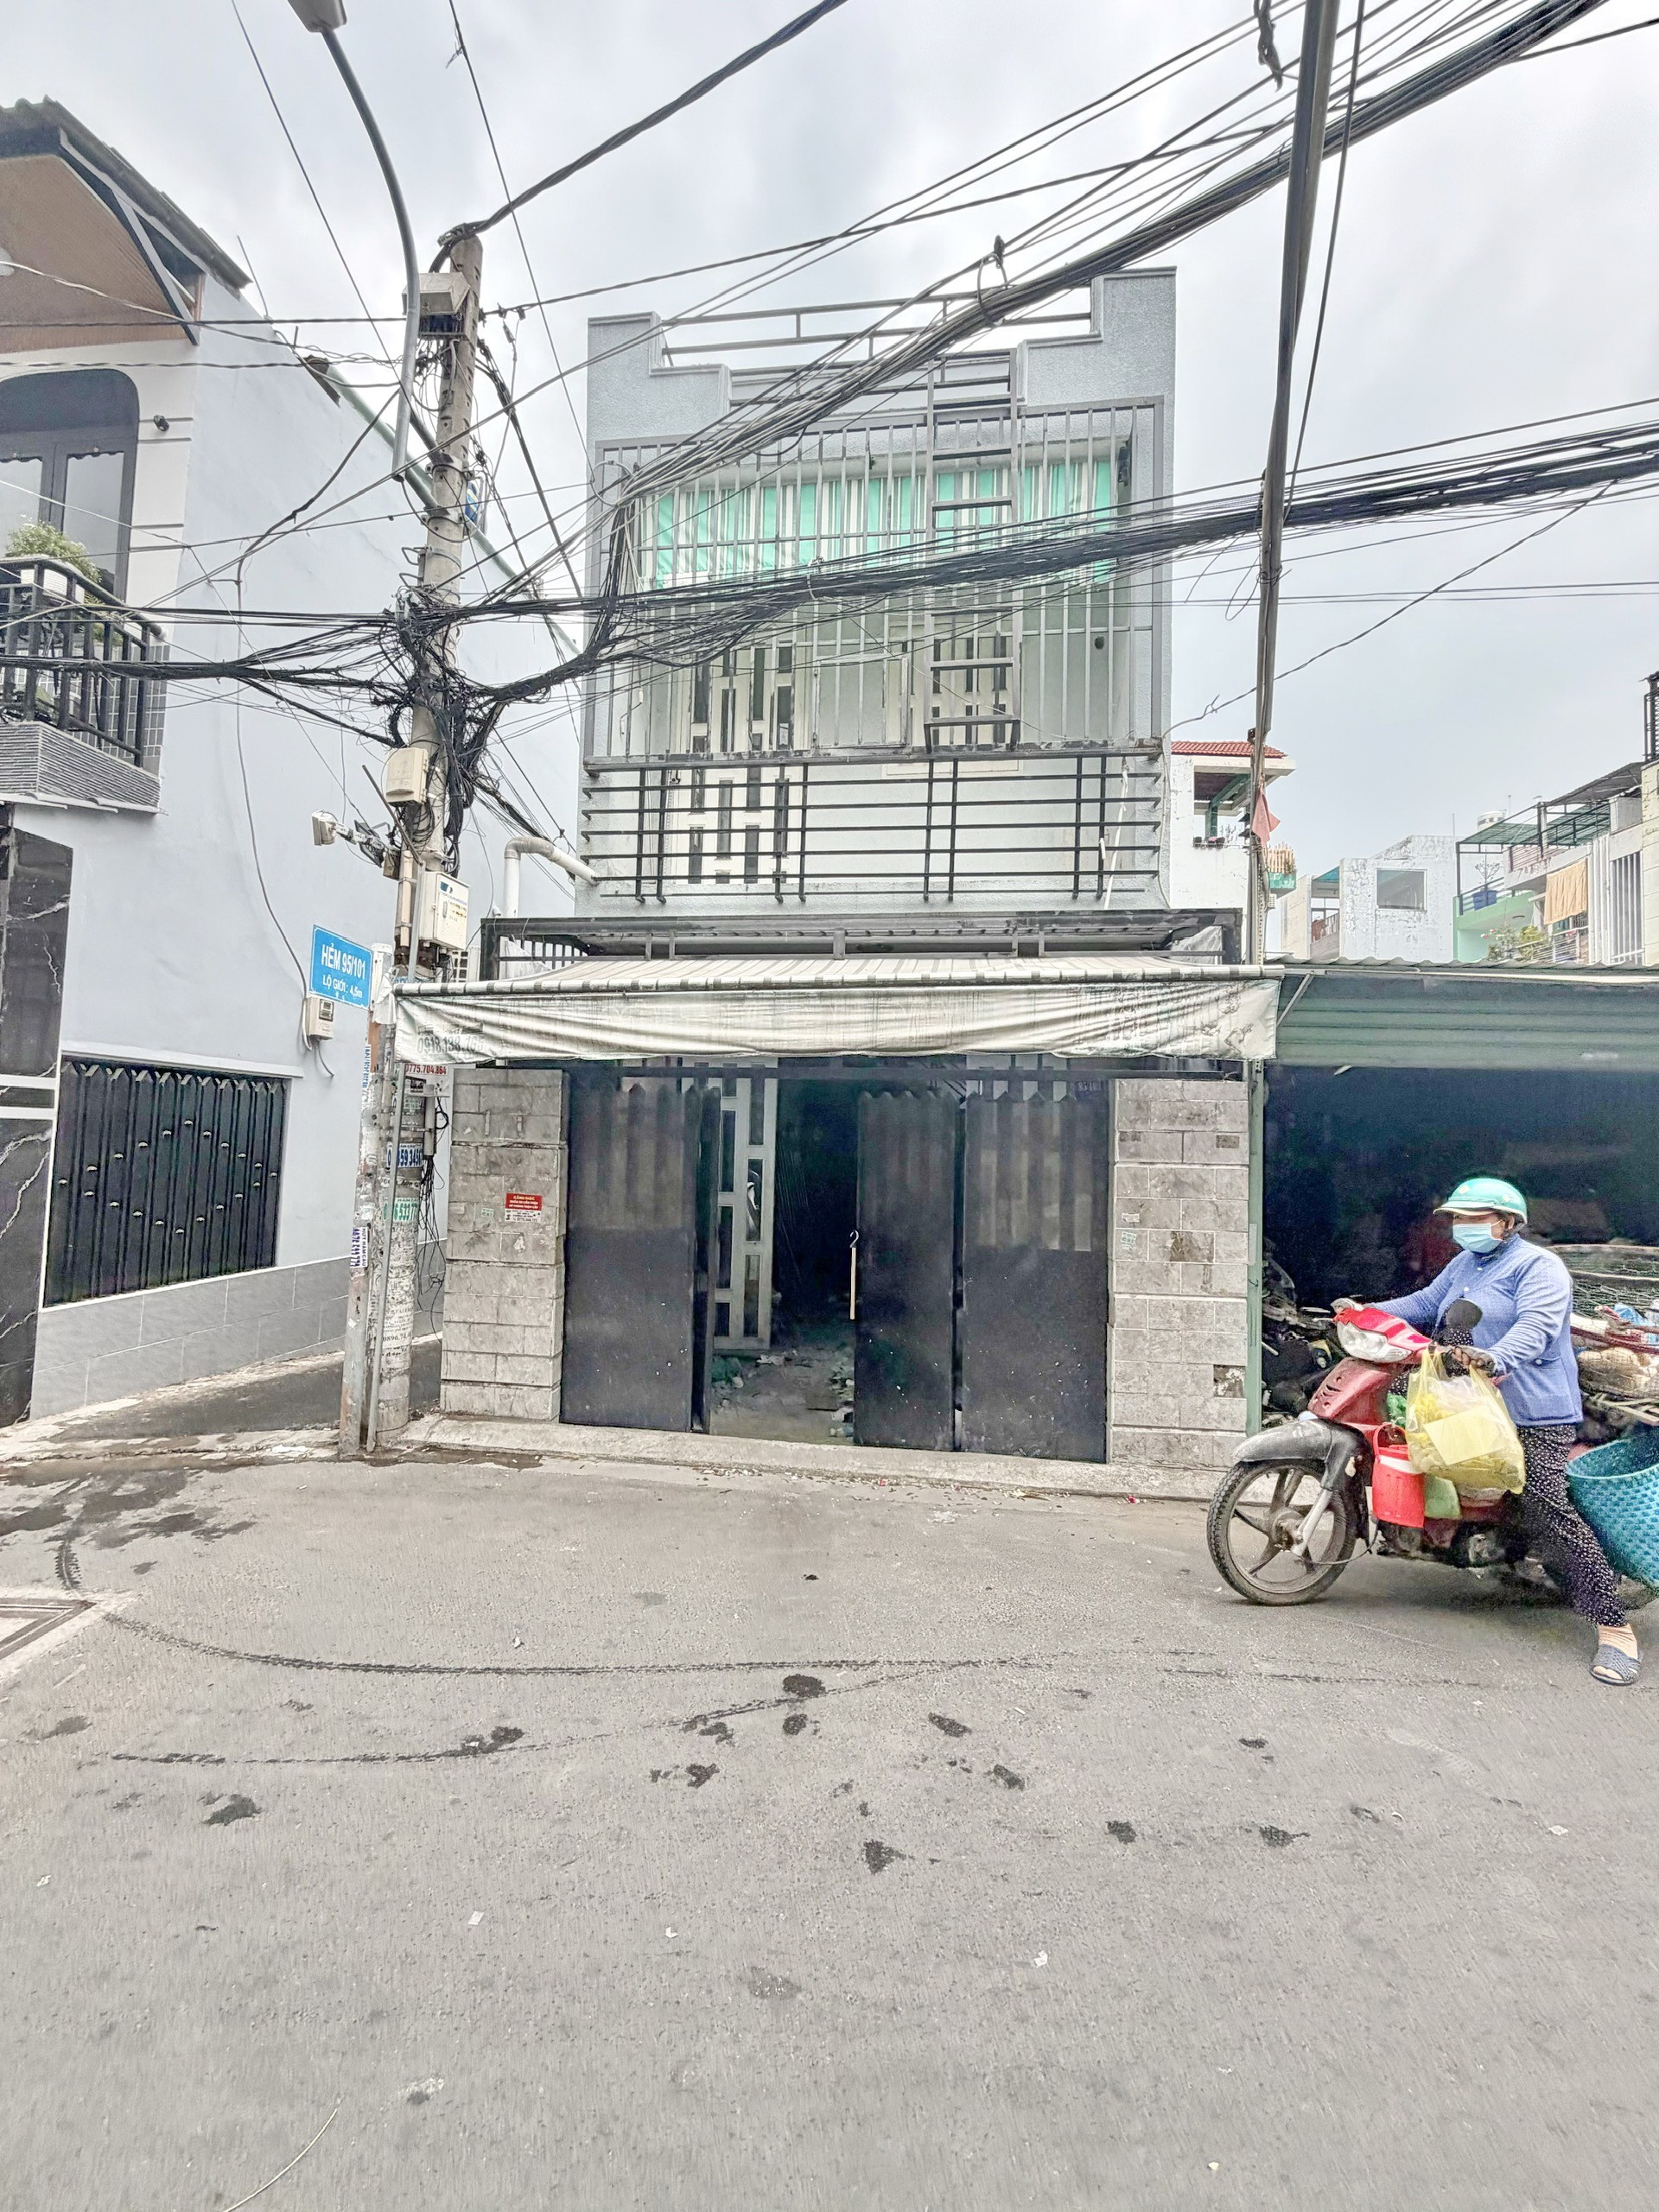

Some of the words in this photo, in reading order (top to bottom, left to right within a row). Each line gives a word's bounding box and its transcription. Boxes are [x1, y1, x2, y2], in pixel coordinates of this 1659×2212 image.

[321, 943, 340, 971] HẺM
[342, 953, 365, 980] 95/101
[322, 974, 333, 989] LỘ
